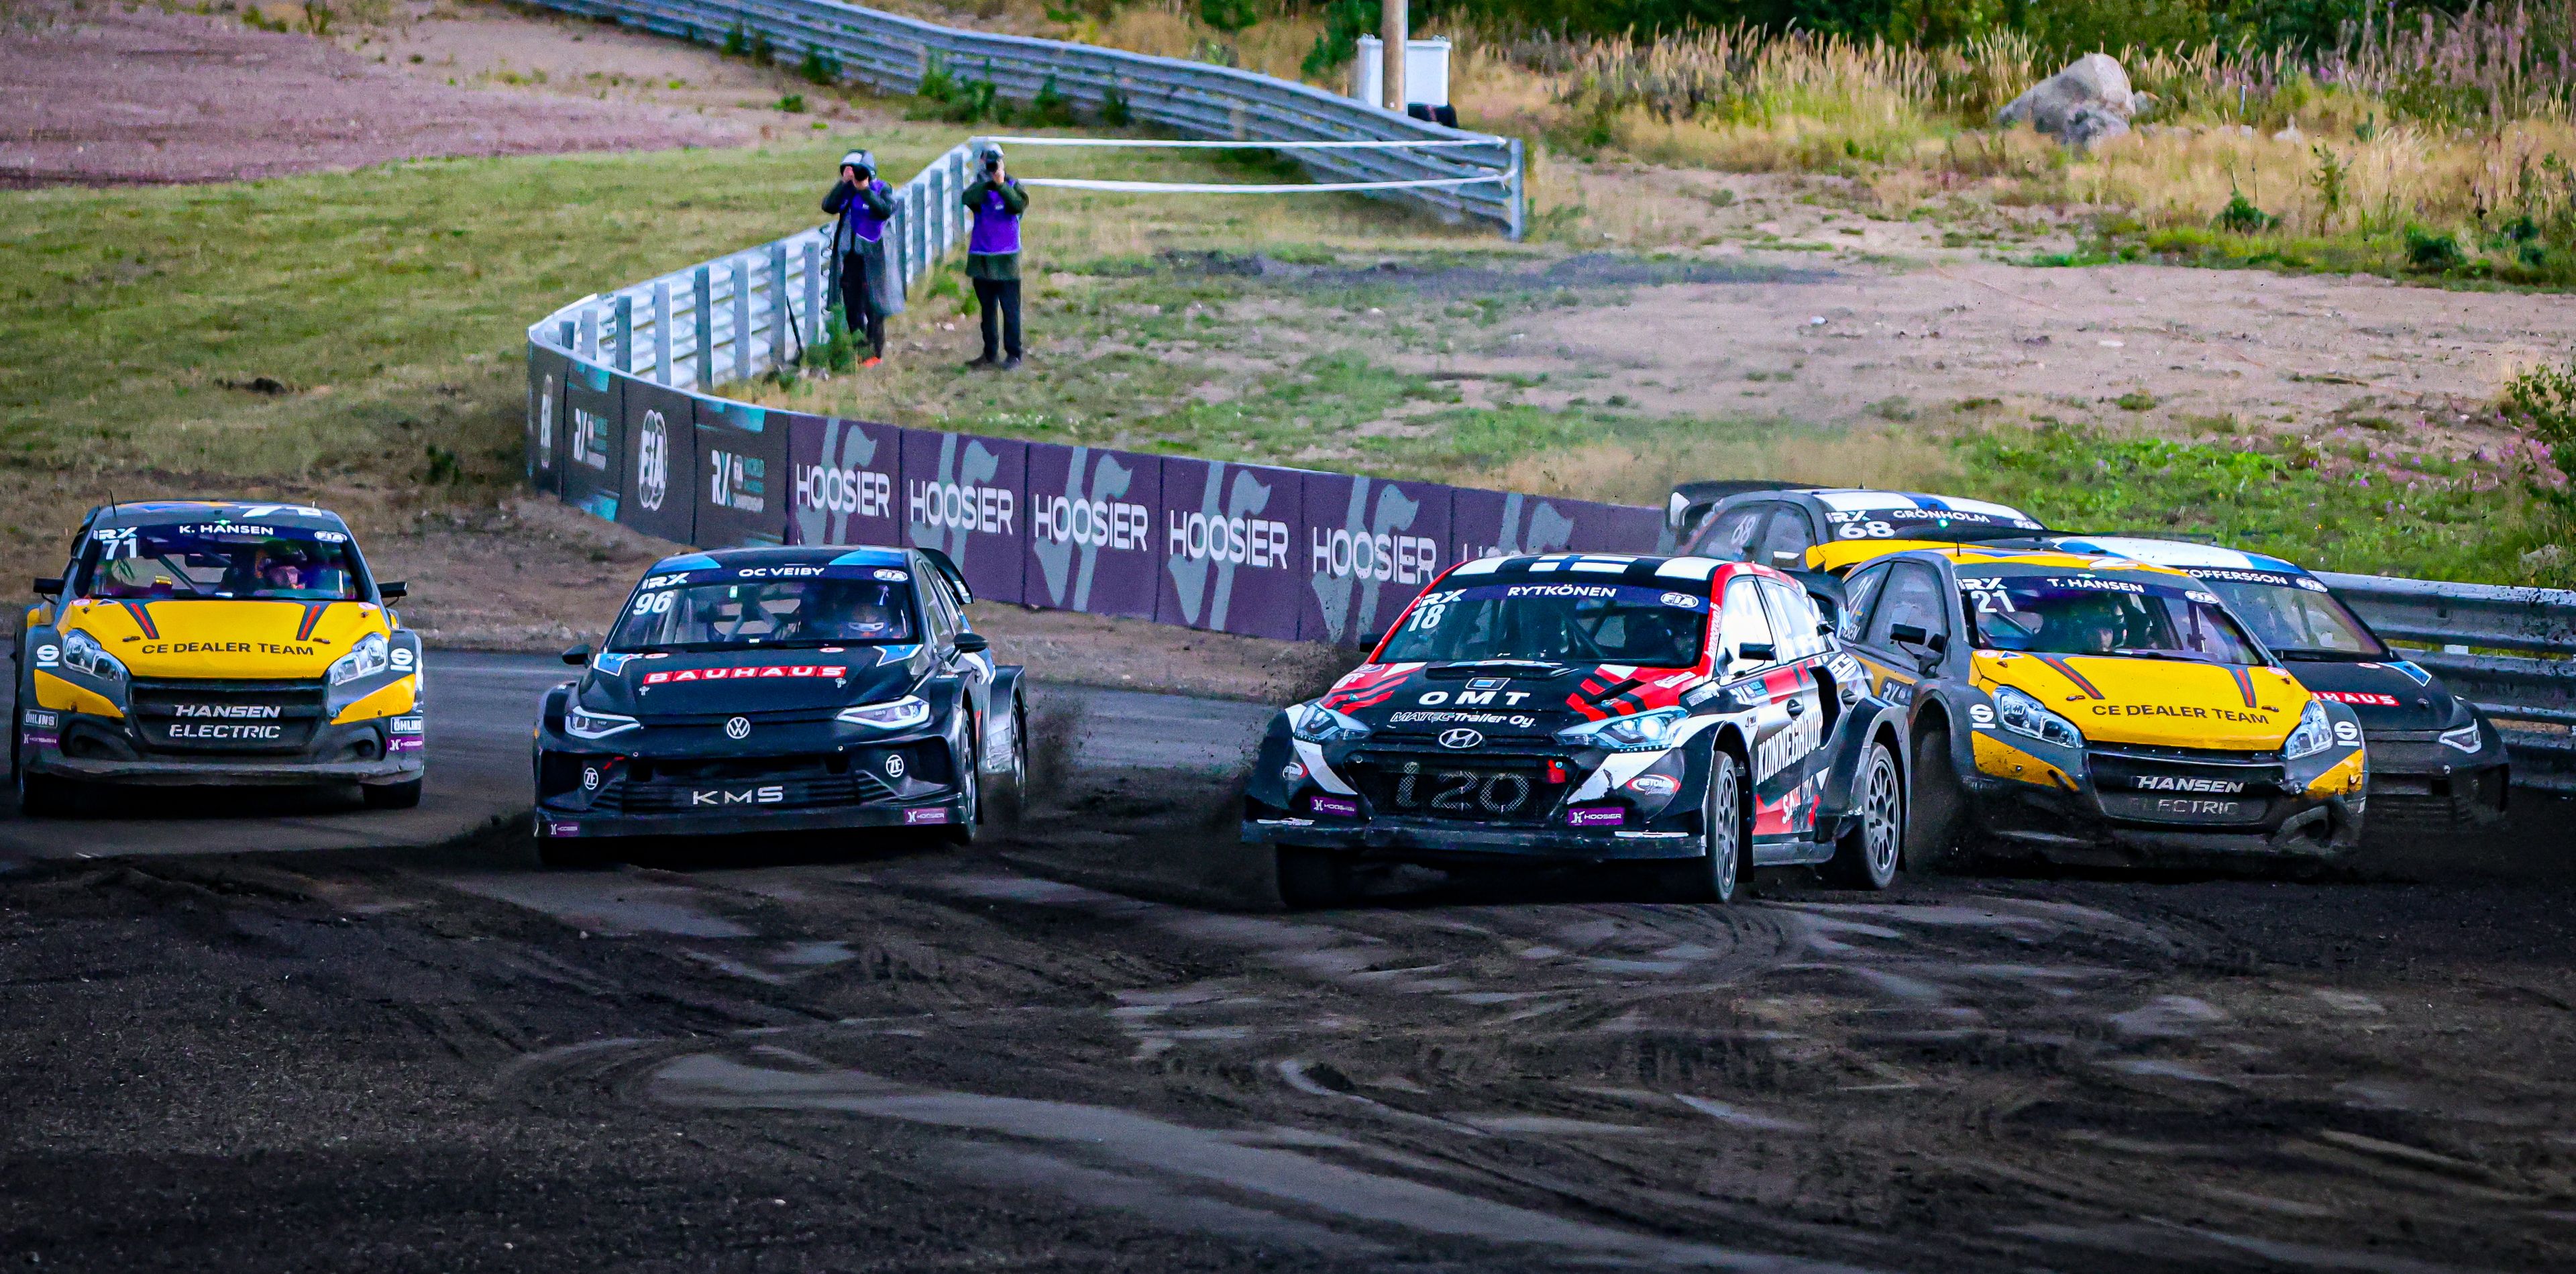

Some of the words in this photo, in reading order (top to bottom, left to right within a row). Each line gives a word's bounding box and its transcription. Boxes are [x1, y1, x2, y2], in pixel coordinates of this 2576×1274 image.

[796, 463, 890, 517] HOOSIER
[909, 478, 1013, 535] HOOSIER
[1033, 494, 1148, 551] HOOSIER
[1892, 507, 1990, 523] GRÖNHOLM
[179, 525, 195, 534] K.
[201, 525, 274, 535] HANSEN
[1839, 521, 1896, 537] 68
[1168, 509, 1289, 570] HOOSIER
[103, 538, 137, 560] 71
[1311, 526, 1436, 584] HOOSIER
[739, 568, 767, 577] OC
[770, 567, 824, 576] VEIBY
[875, 570, 906, 581] FIA
[2184, 569, 2288, 585] OFFERSSON
[1507, 584, 1617, 598] RYTKÖNEN
[2047, 578, 2064, 588] T.
[2069, 579, 2145, 593] HANSEN
[633, 590, 674, 615] 96
[1663, 593, 1697, 607] FIA
[1970, 590, 2016, 613] 21
[1408, 604, 1446, 632] 18
[142, 643, 168, 654] CE
[173, 642, 251, 653] DEALER
[257, 642, 314, 656] TEAM
[646, 667, 847, 684] BAUHAUS
[1418, 691, 1530, 705] OMT
[2312, 692, 2396, 706] HAUS
[174, 705, 281, 719] HANSEN
[2092, 705, 2121, 716] CE
[2125, 704, 2207, 719] DEALER
[2210, 708, 2269, 725] TEAM
[1509, 715, 1536, 728] Oy
[169, 724, 281, 739] ELECTRIC
[1756, 711, 1823, 786] KONNEGROUP
[1396, 761, 1530, 813] i20
[2137, 776, 2245, 793] HANSEN
[693, 786, 784, 805] KMS
[2129, 798, 2240, 814] ECTRIC
